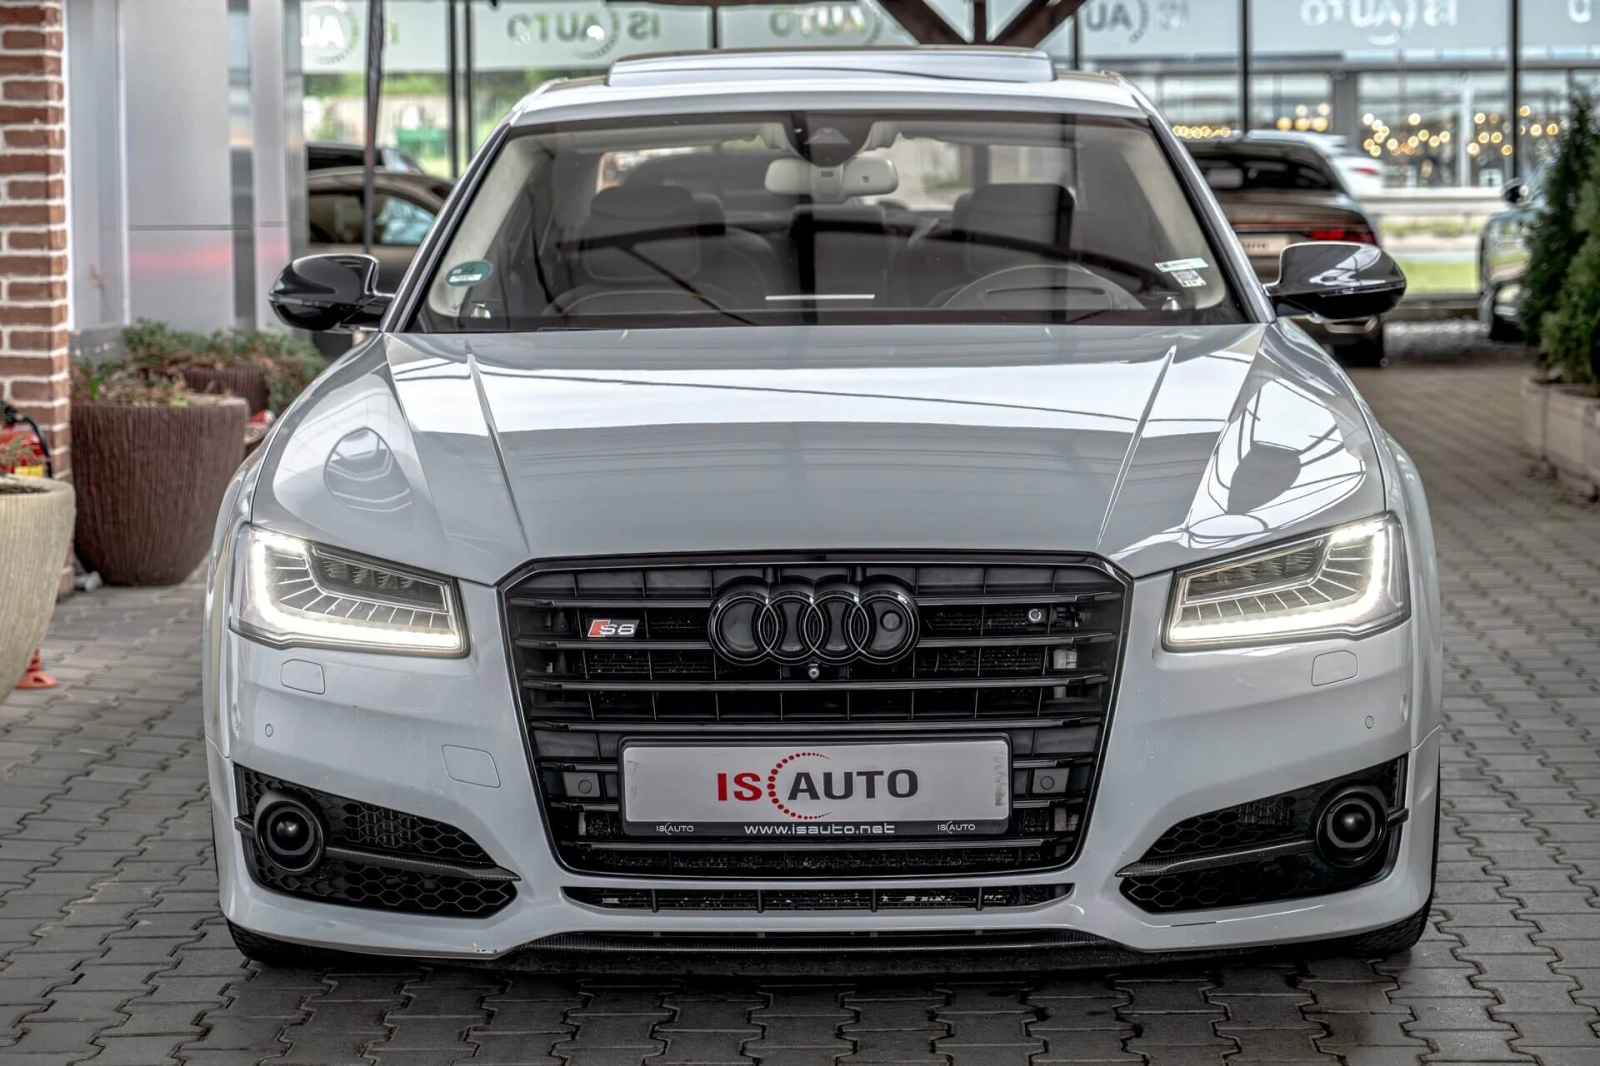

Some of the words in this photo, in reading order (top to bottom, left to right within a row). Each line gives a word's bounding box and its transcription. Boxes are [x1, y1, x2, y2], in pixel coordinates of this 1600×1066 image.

[599, 623, 635, 635] S8
[717, 772, 762, 801] IS
[787, 769, 919, 801] AUTO
[744, 823, 896, 835] www.isauto.net
